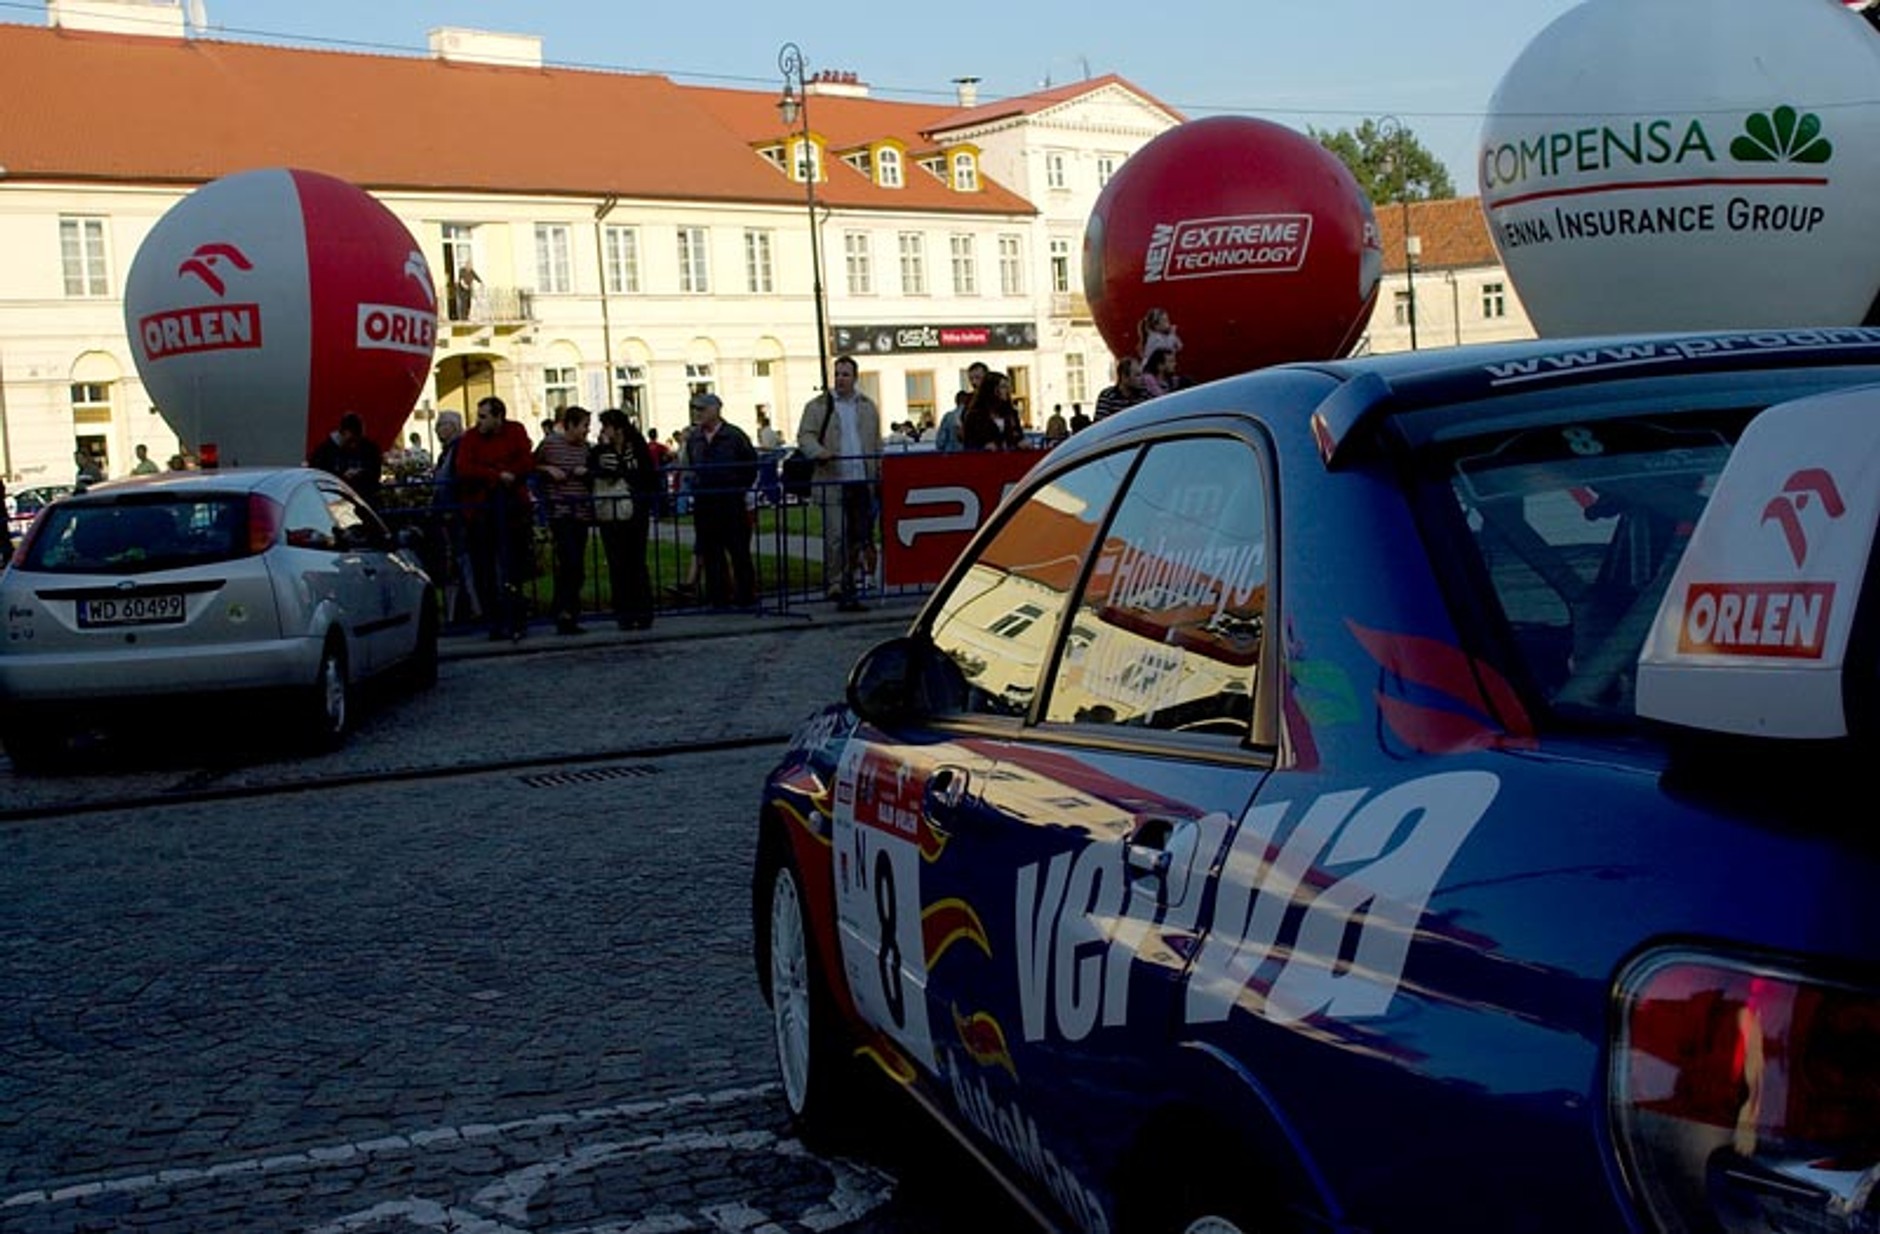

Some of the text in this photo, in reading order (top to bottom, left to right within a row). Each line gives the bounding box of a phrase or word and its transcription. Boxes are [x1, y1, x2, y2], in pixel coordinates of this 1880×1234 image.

[1484, 120, 1716, 189] COMPENSA
[1180, 223, 1300, 249] EXTREME
[1555, 205, 1715, 240] INSURANCE
[1727, 197, 1826, 233] GROUP
[1144, 224, 1173, 283] NEW
[1175, 247, 1297, 270] TECHNOLOGY
[143, 309, 251, 352] ORLEN
[364, 311, 434, 347] ORLE
[1562, 428, 1604, 455] 8
[90, 597, 180, 619] WD 60499
[1688, 593, 1824, 646] ORLEN
[875, 849, 905, 1029] 8
